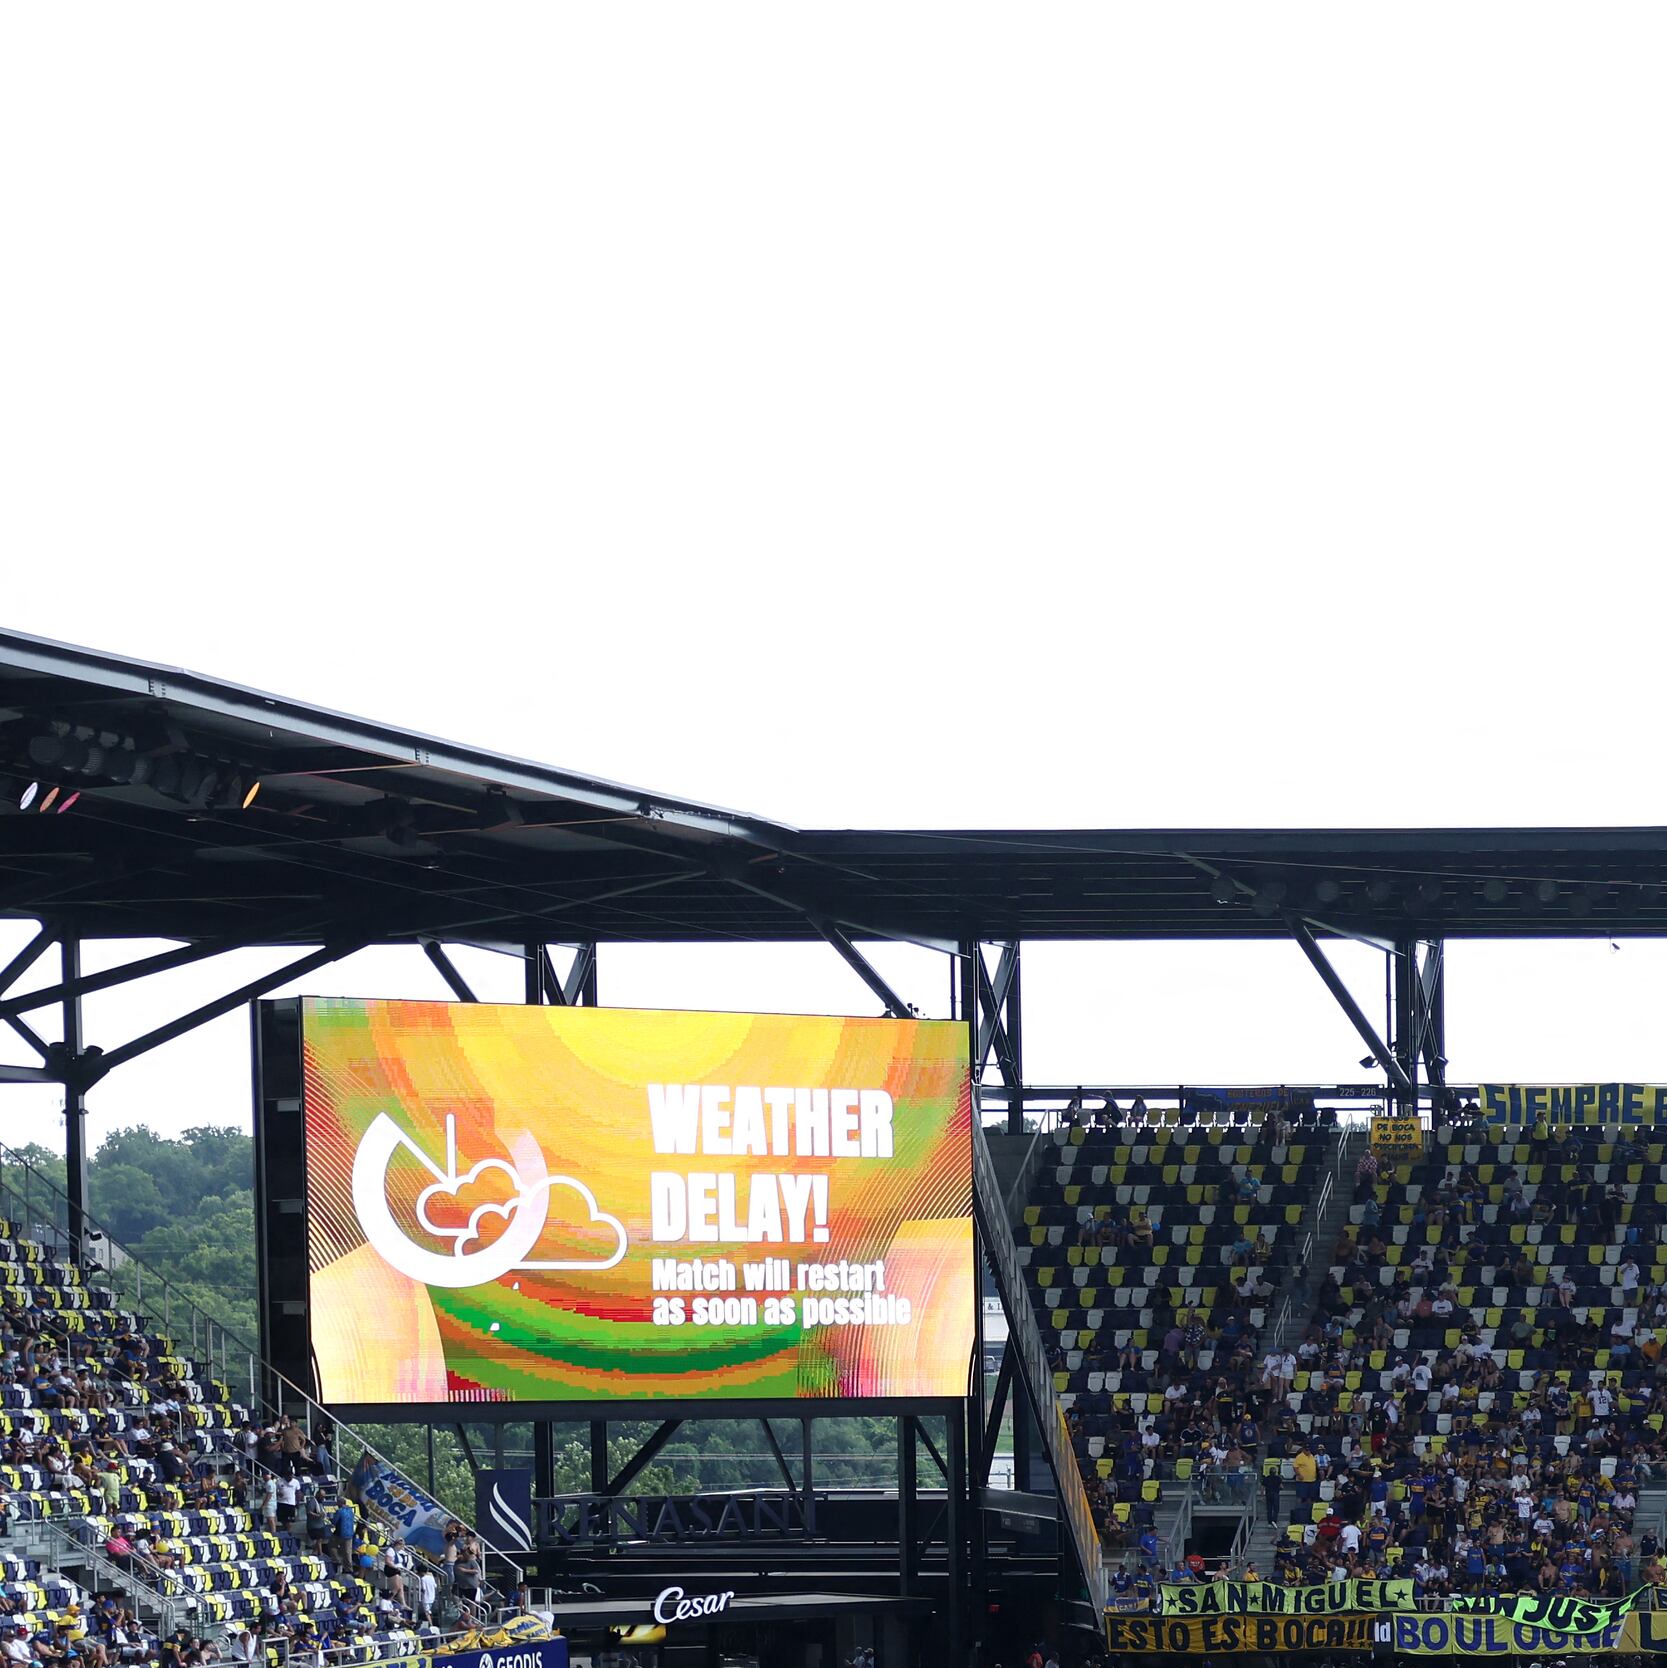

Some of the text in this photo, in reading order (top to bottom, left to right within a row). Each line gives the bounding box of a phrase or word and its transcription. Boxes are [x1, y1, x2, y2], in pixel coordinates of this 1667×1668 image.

[648, 1084, 894, 1157] WEATHER
[1484, 1084, 1644, 1124] SIEMPRE
[649, 1172, 829, 1243] DELAY!
[652, 1258, 885, 1293] Match will restart
[652, 1293, 911, 1328] as soon as possible
[366, 1480, 417, 1527] BOCA
[534, 1491, 828, 1544] RENASANT
[653, 1586, 735, 1624] Cesar
[1179, 1579, 1397, 1614] SAN MIGUEL
[1110, 1616, 1237, 1650] ESTO ES
